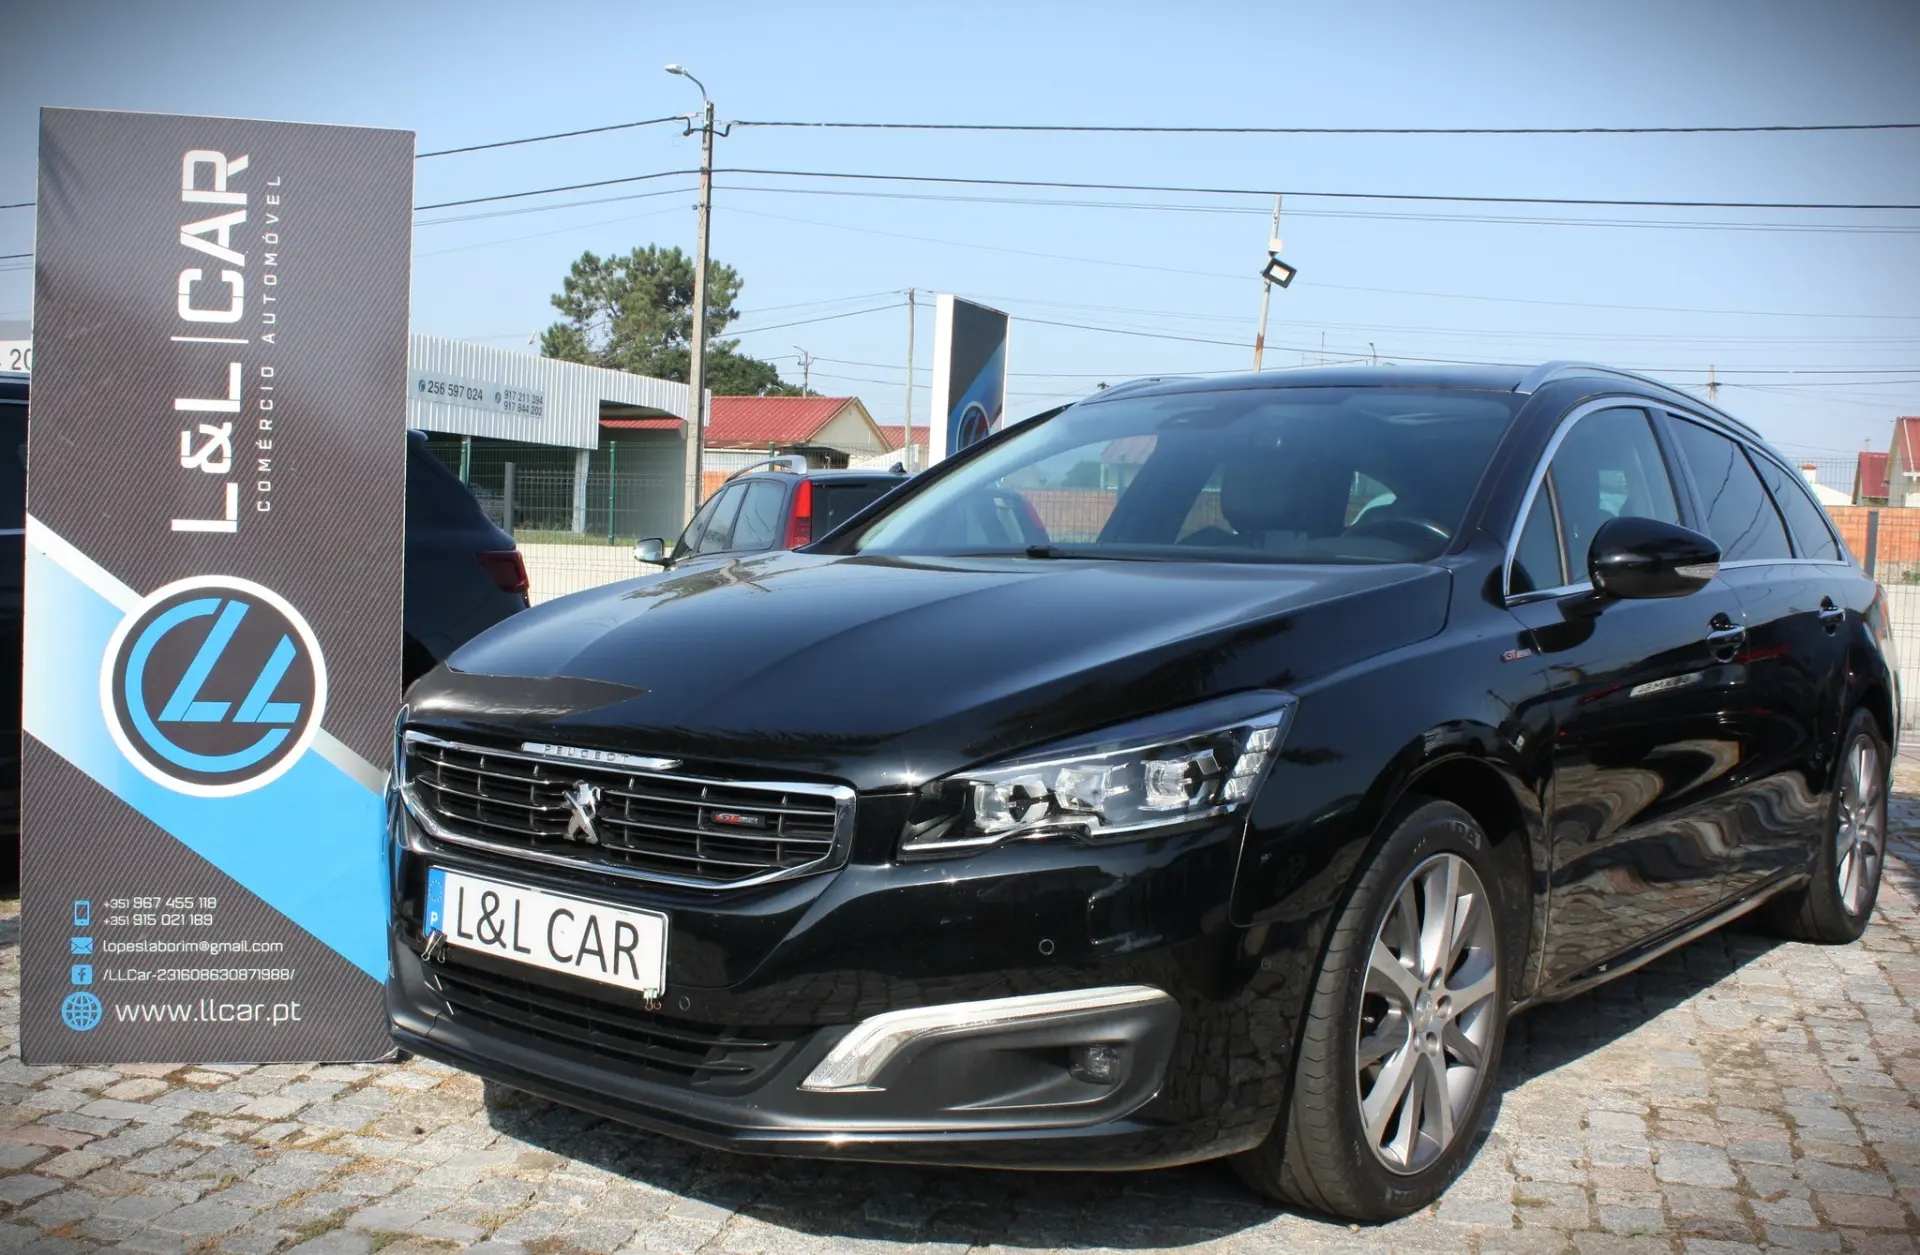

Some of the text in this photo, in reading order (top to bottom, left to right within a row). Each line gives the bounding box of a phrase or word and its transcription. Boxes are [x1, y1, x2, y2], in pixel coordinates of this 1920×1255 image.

[171, 149, 249, 533] L&L CAR
[256, 176, 281, 512] COMÉRCIO AUTOMÓVEL
[427, 380, 483, 401] 256 597 024
[504, 390, 516, 400] 917
[518, 392, 530, 403] 211
[503, 401, 516, 411] 917
[531, 406, 543, 416] 202
[544, 744, 630, 764] PEUGEOT
[104, 896, 217, 909] +351 967 455 118
[104, 913, 213, 926] +351 915 021 189
[430, 911, 438, 926] P
[457, 886, 640, 980] L&L CAR
[103, 940, 283, 955] lopeslaborim@gmail.com
[103, 968, 295, 981] /LLCar-231608630871988/
[115, 998, 301, 1026] www.llcar.pt
